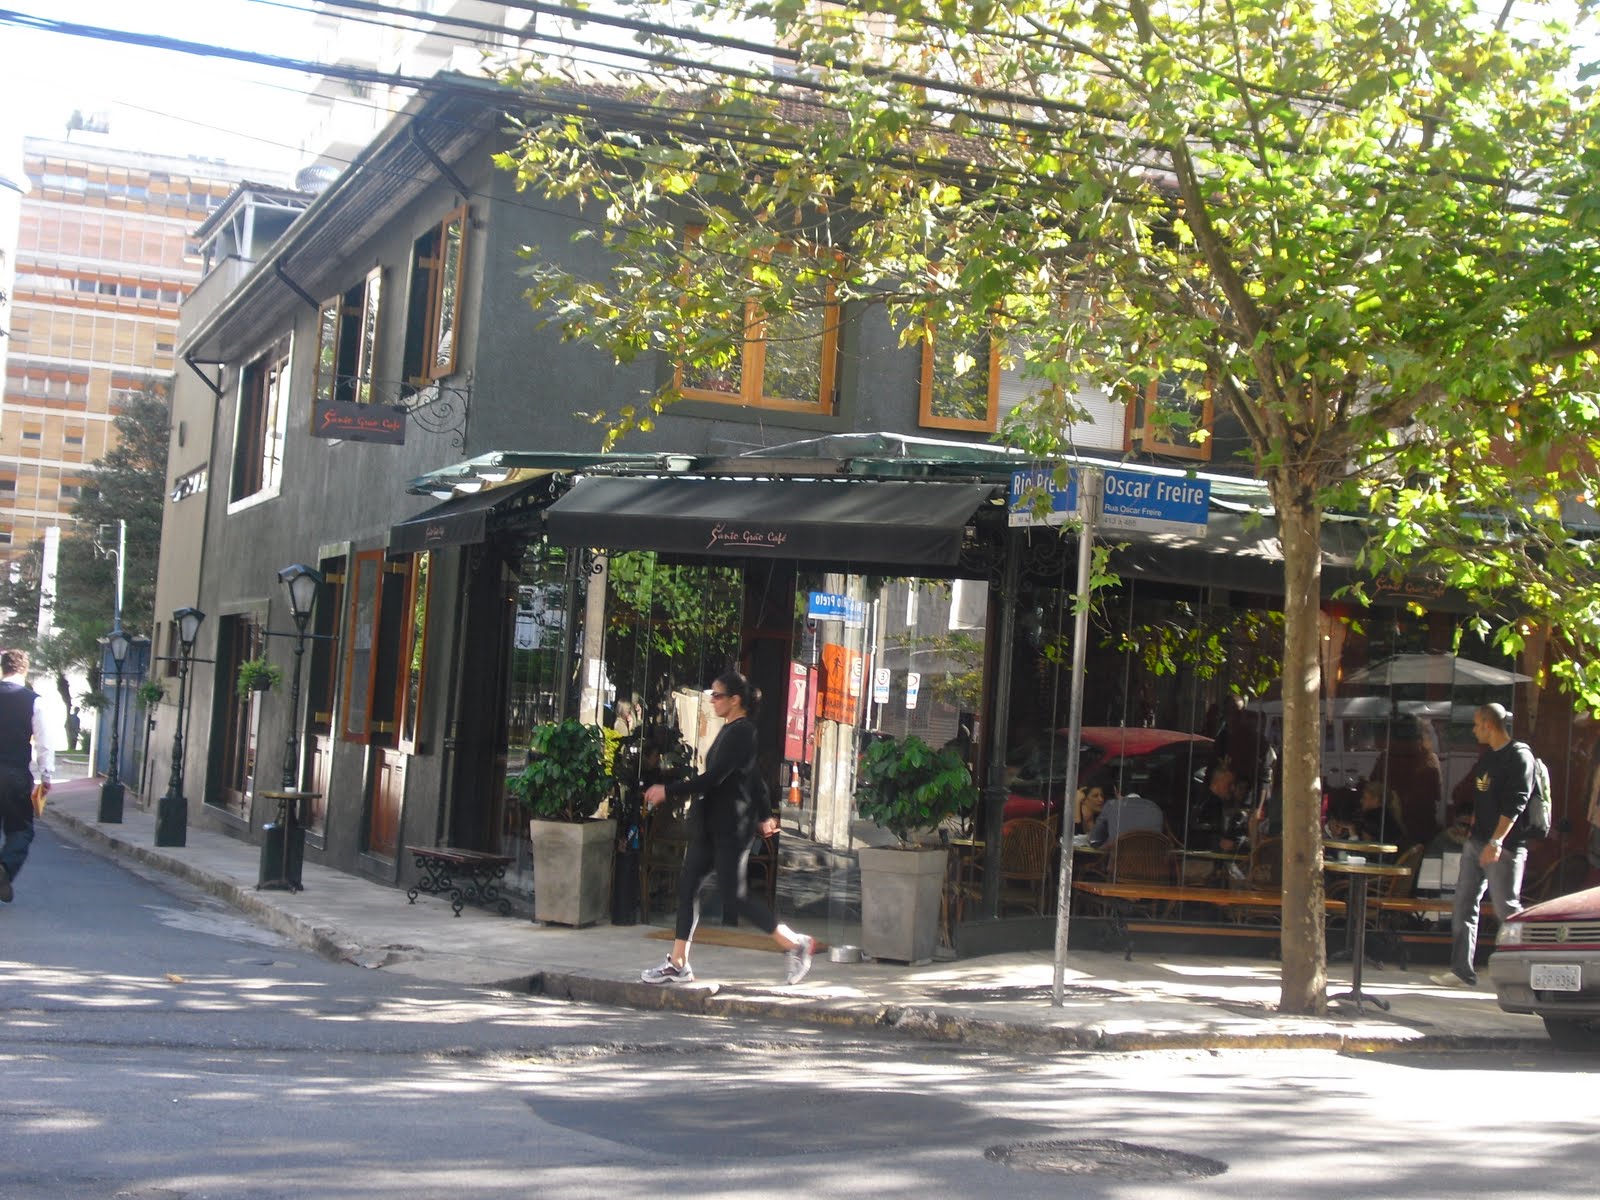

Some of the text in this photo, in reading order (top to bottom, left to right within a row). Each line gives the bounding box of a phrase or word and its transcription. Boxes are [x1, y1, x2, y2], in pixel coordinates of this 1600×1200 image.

[1013, 473, 1032, 495] Rio
[1105, 475, 1204, 505] Oscar Freire
[1104, 503, 1162, 517] Rua Oscar Freire
[706, 521, 787, 549] Santo Grão Café
